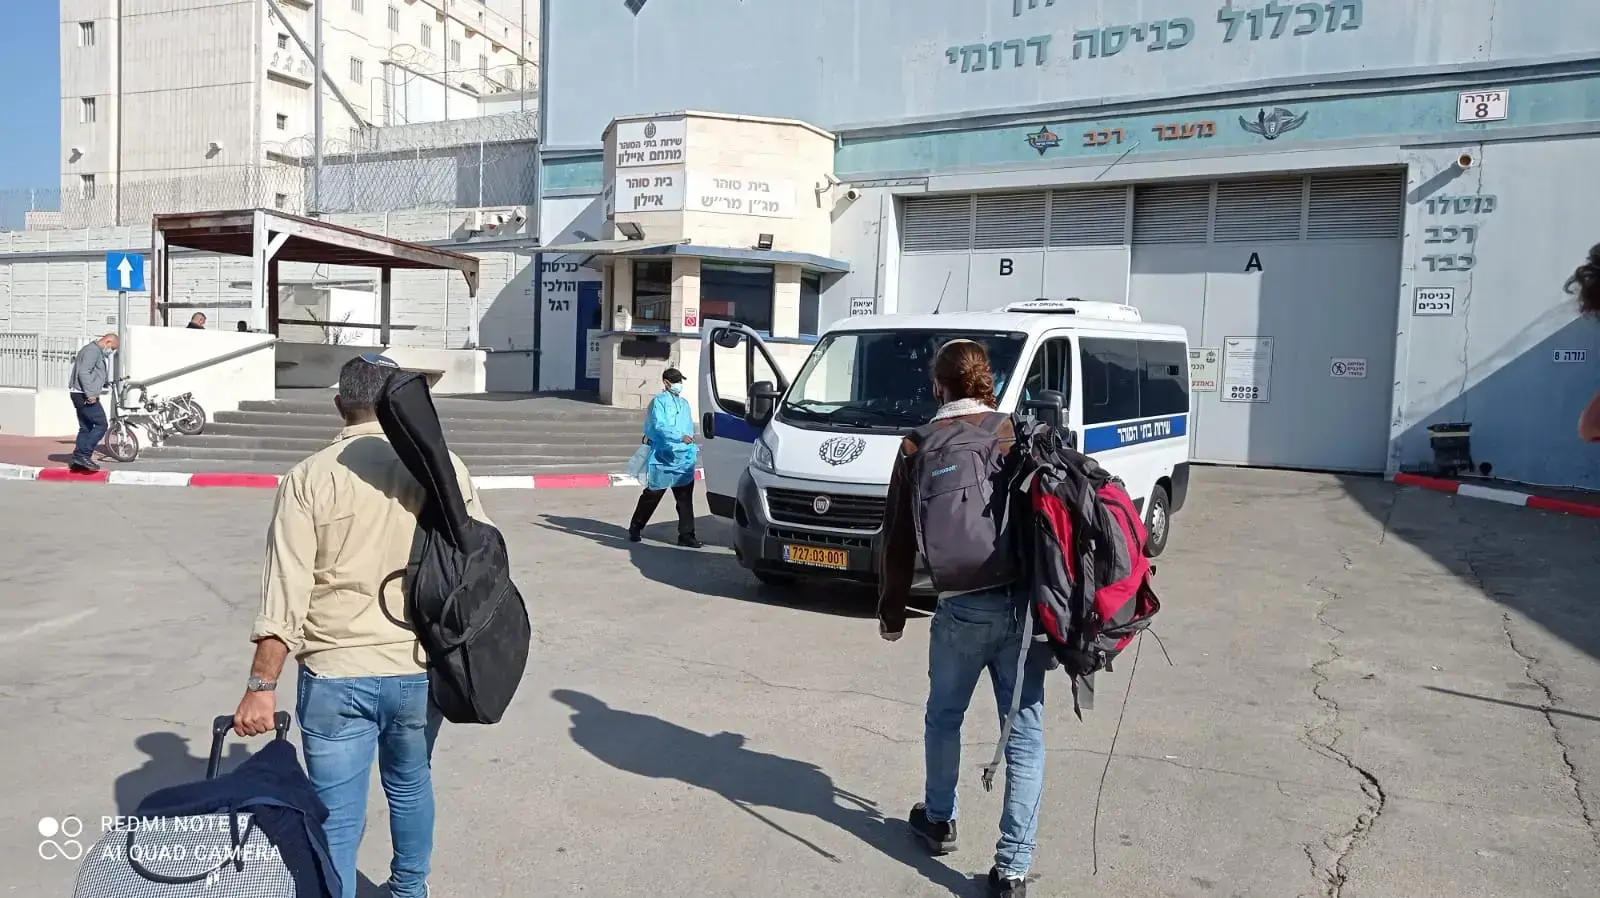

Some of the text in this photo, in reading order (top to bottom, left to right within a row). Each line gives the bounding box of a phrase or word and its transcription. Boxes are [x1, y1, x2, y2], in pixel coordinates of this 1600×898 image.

[945, 0, 1364, 73] מכלול כניסה דרומי
[1465, 93, 1501, 103] גזרה
[1475, 103, 1488, 118] 8
[1082, 120, 1217, 148] מעבר רכב
[619, 138, 682, 150] שירות בתי הסוהר
[618, 149, 682, 165] מתחם איילון
[625, 176, 673, 188] בית סוהר
[712, 178, 770, 192] בית סוהר
[633, 194, 664, 210] איילון
[1424, 225, 1479, 244] רכב
[541, 262, 578, 273] כניסת
[999, 258, 1014, 276] B
[1245, 252, 1263, 272] A
[1421, 253, 1477, 272] כבד
[543, 279, 577, 292] הולכי
[1419, 292, 1450, 300] כניסת
[548, 298, 569, 311] רגל
[1554, 351, 1560, 361] 8
[1116, 420, 1171, 443] שירות בתי הסוהר
